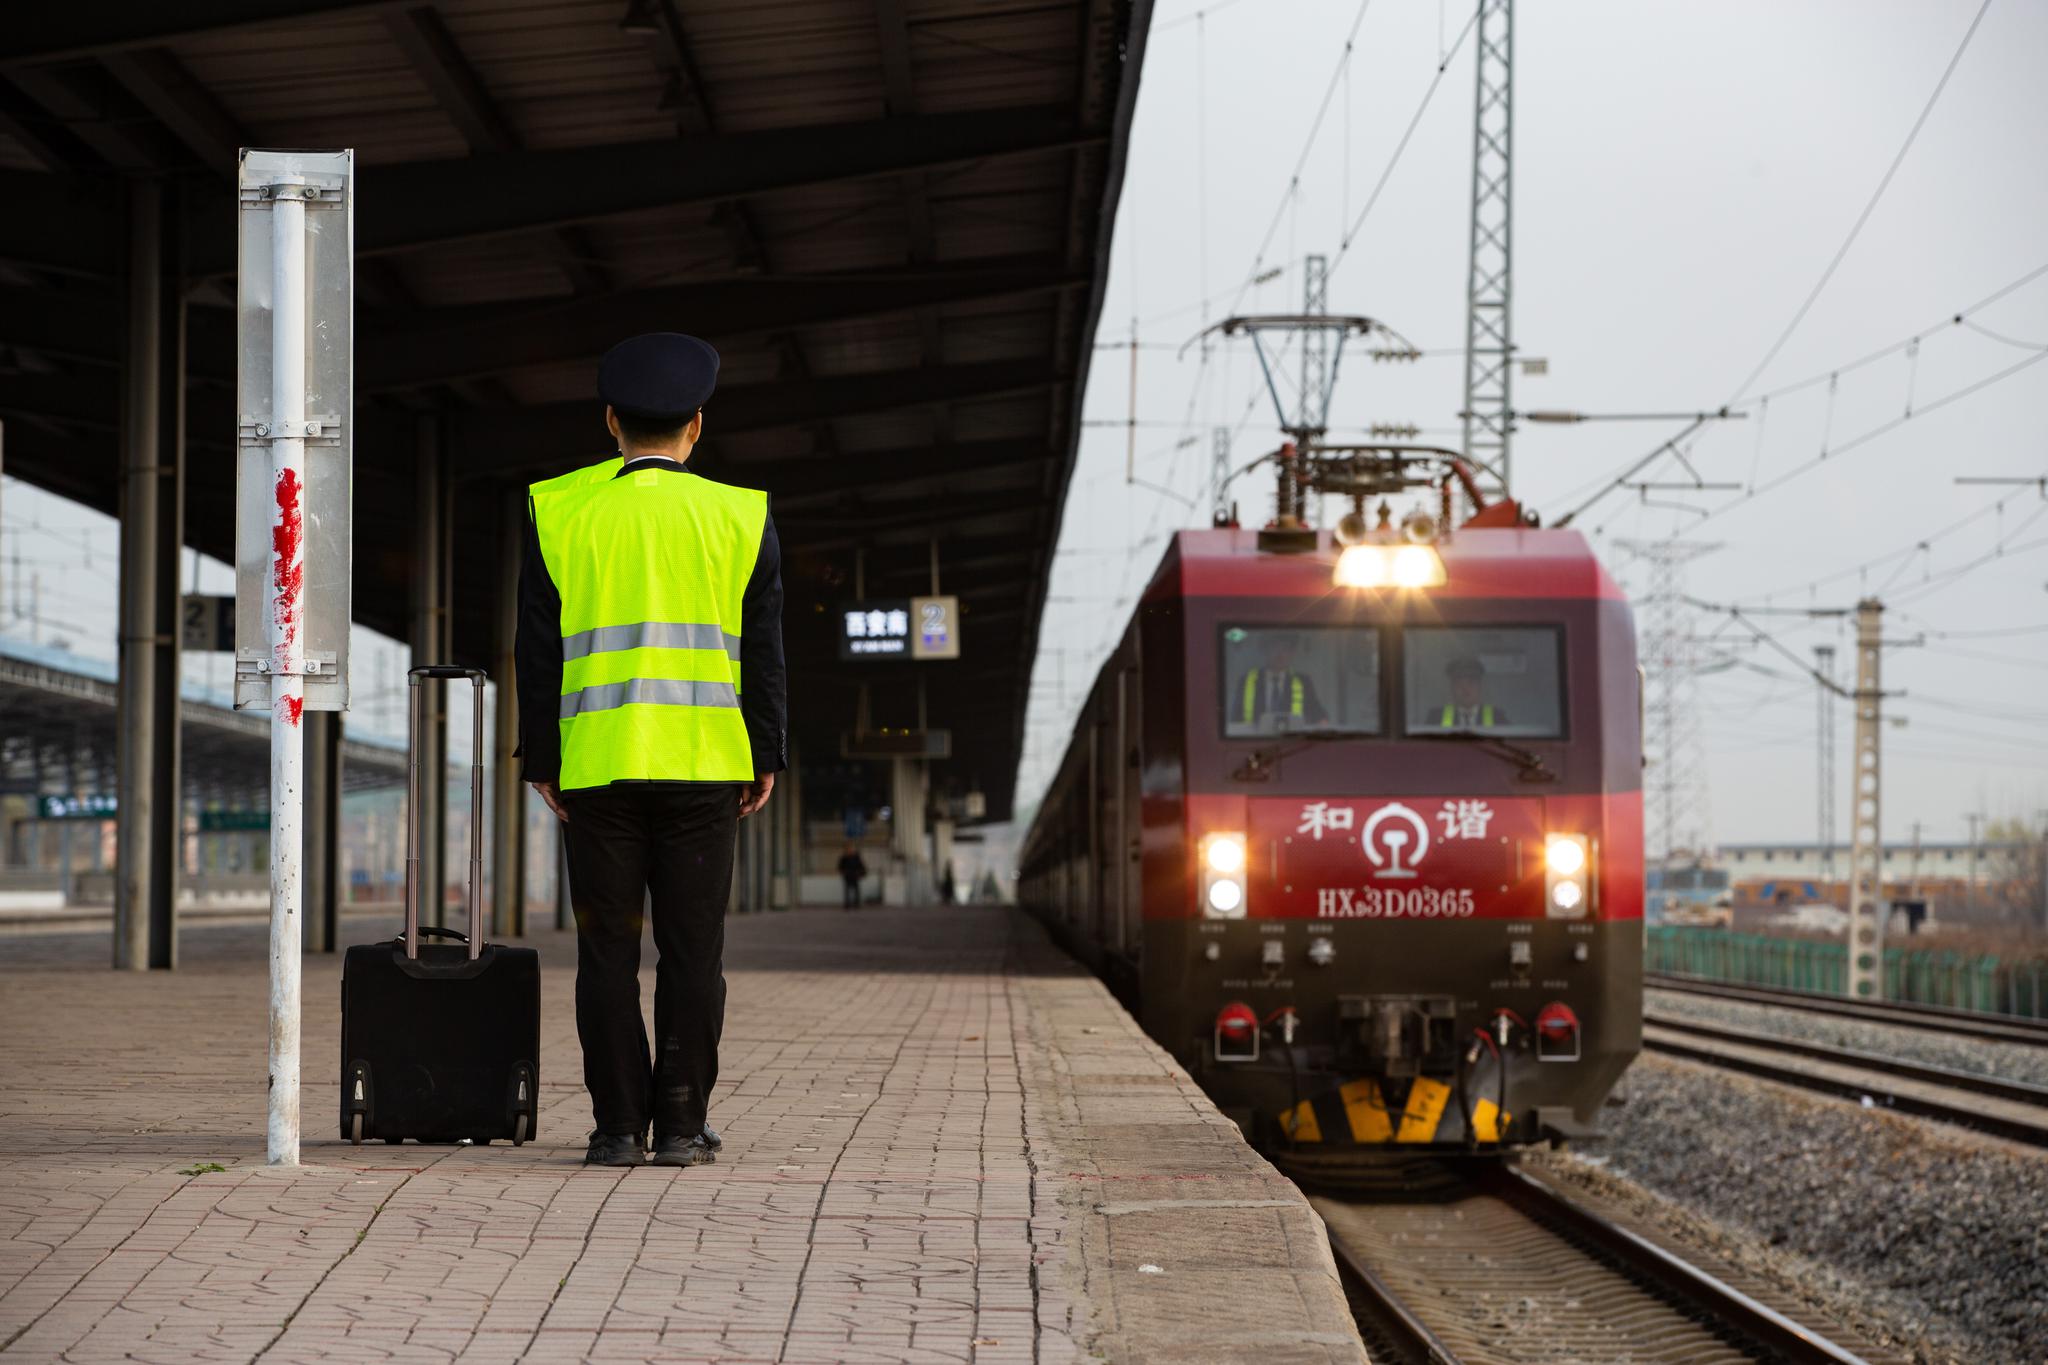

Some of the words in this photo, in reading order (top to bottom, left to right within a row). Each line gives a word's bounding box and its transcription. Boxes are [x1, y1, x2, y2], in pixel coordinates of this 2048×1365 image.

[186, 601, 206, 628] 2
[921, 603, 946, 634] 2
[1297, 801, 1353, 840] 和
